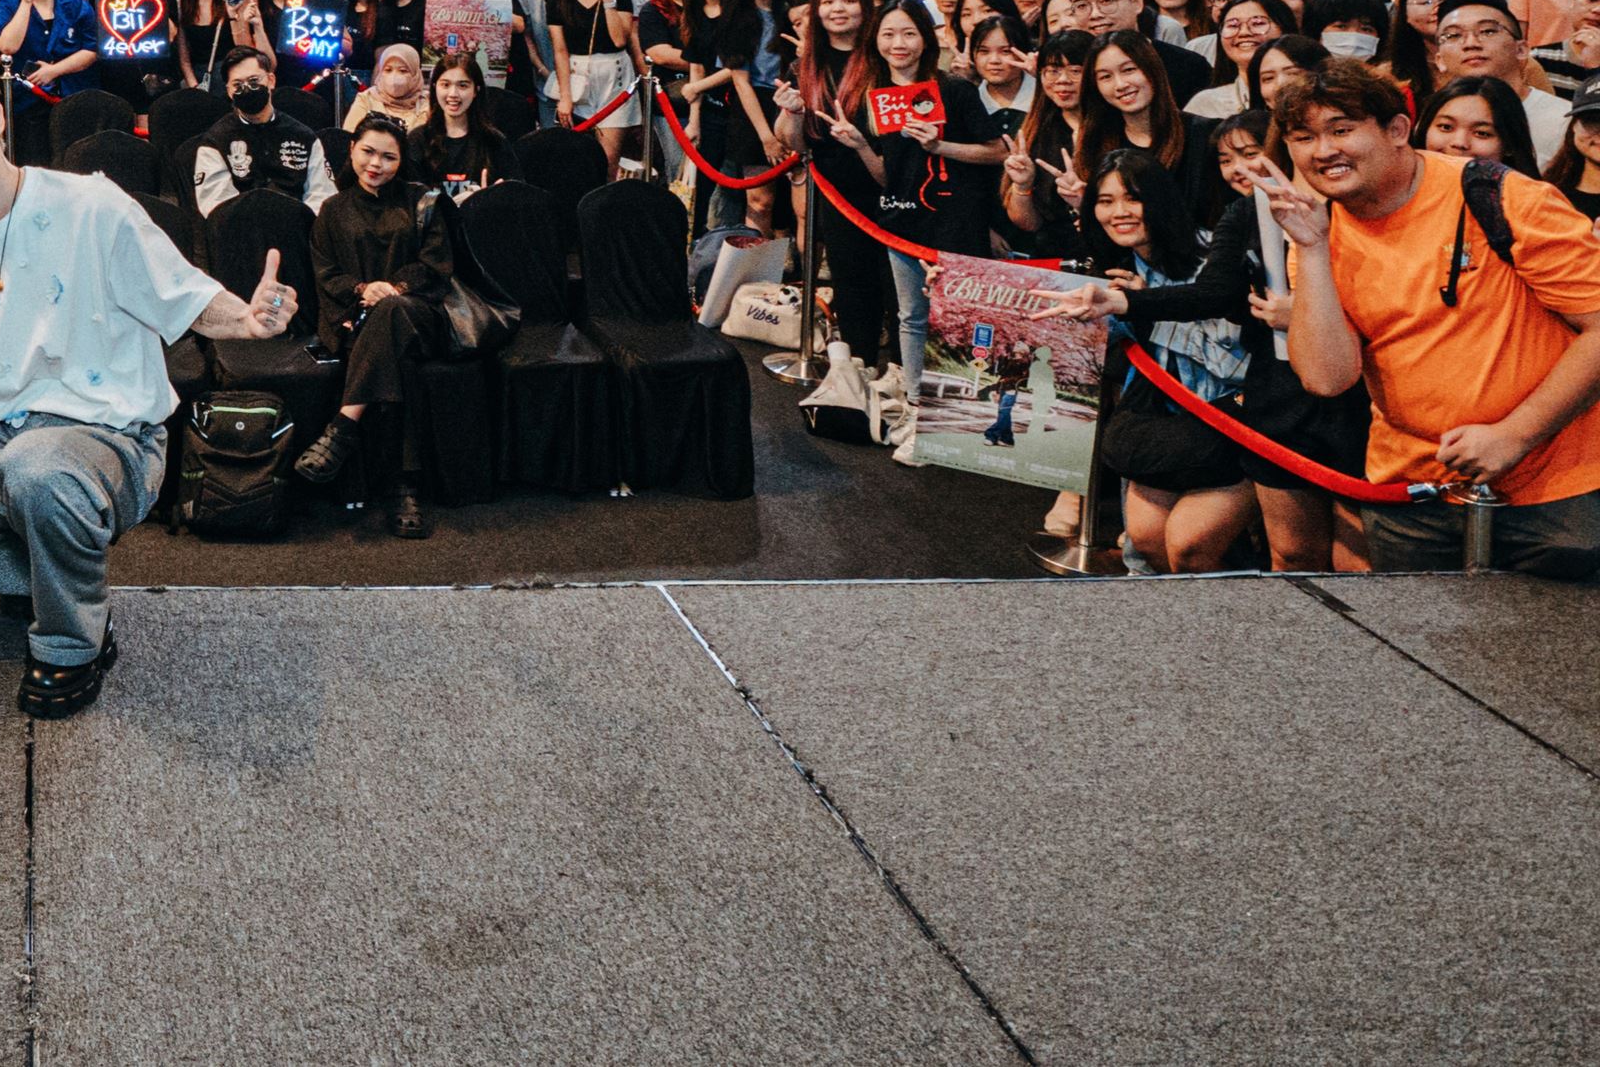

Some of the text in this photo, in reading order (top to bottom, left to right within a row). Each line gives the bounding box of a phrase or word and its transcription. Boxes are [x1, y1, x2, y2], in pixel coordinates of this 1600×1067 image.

[111, 8, 145, 30] Bii
[286, 5, 339, 45] Bii
[103, 37, 166, 56] 4ever
[311, 41, 339, 57] MY
[875, 93, 909, 115] Bii
[944, 276, 1042, 312] Bii WITH
[747, 305, 780, 325] Vibes
